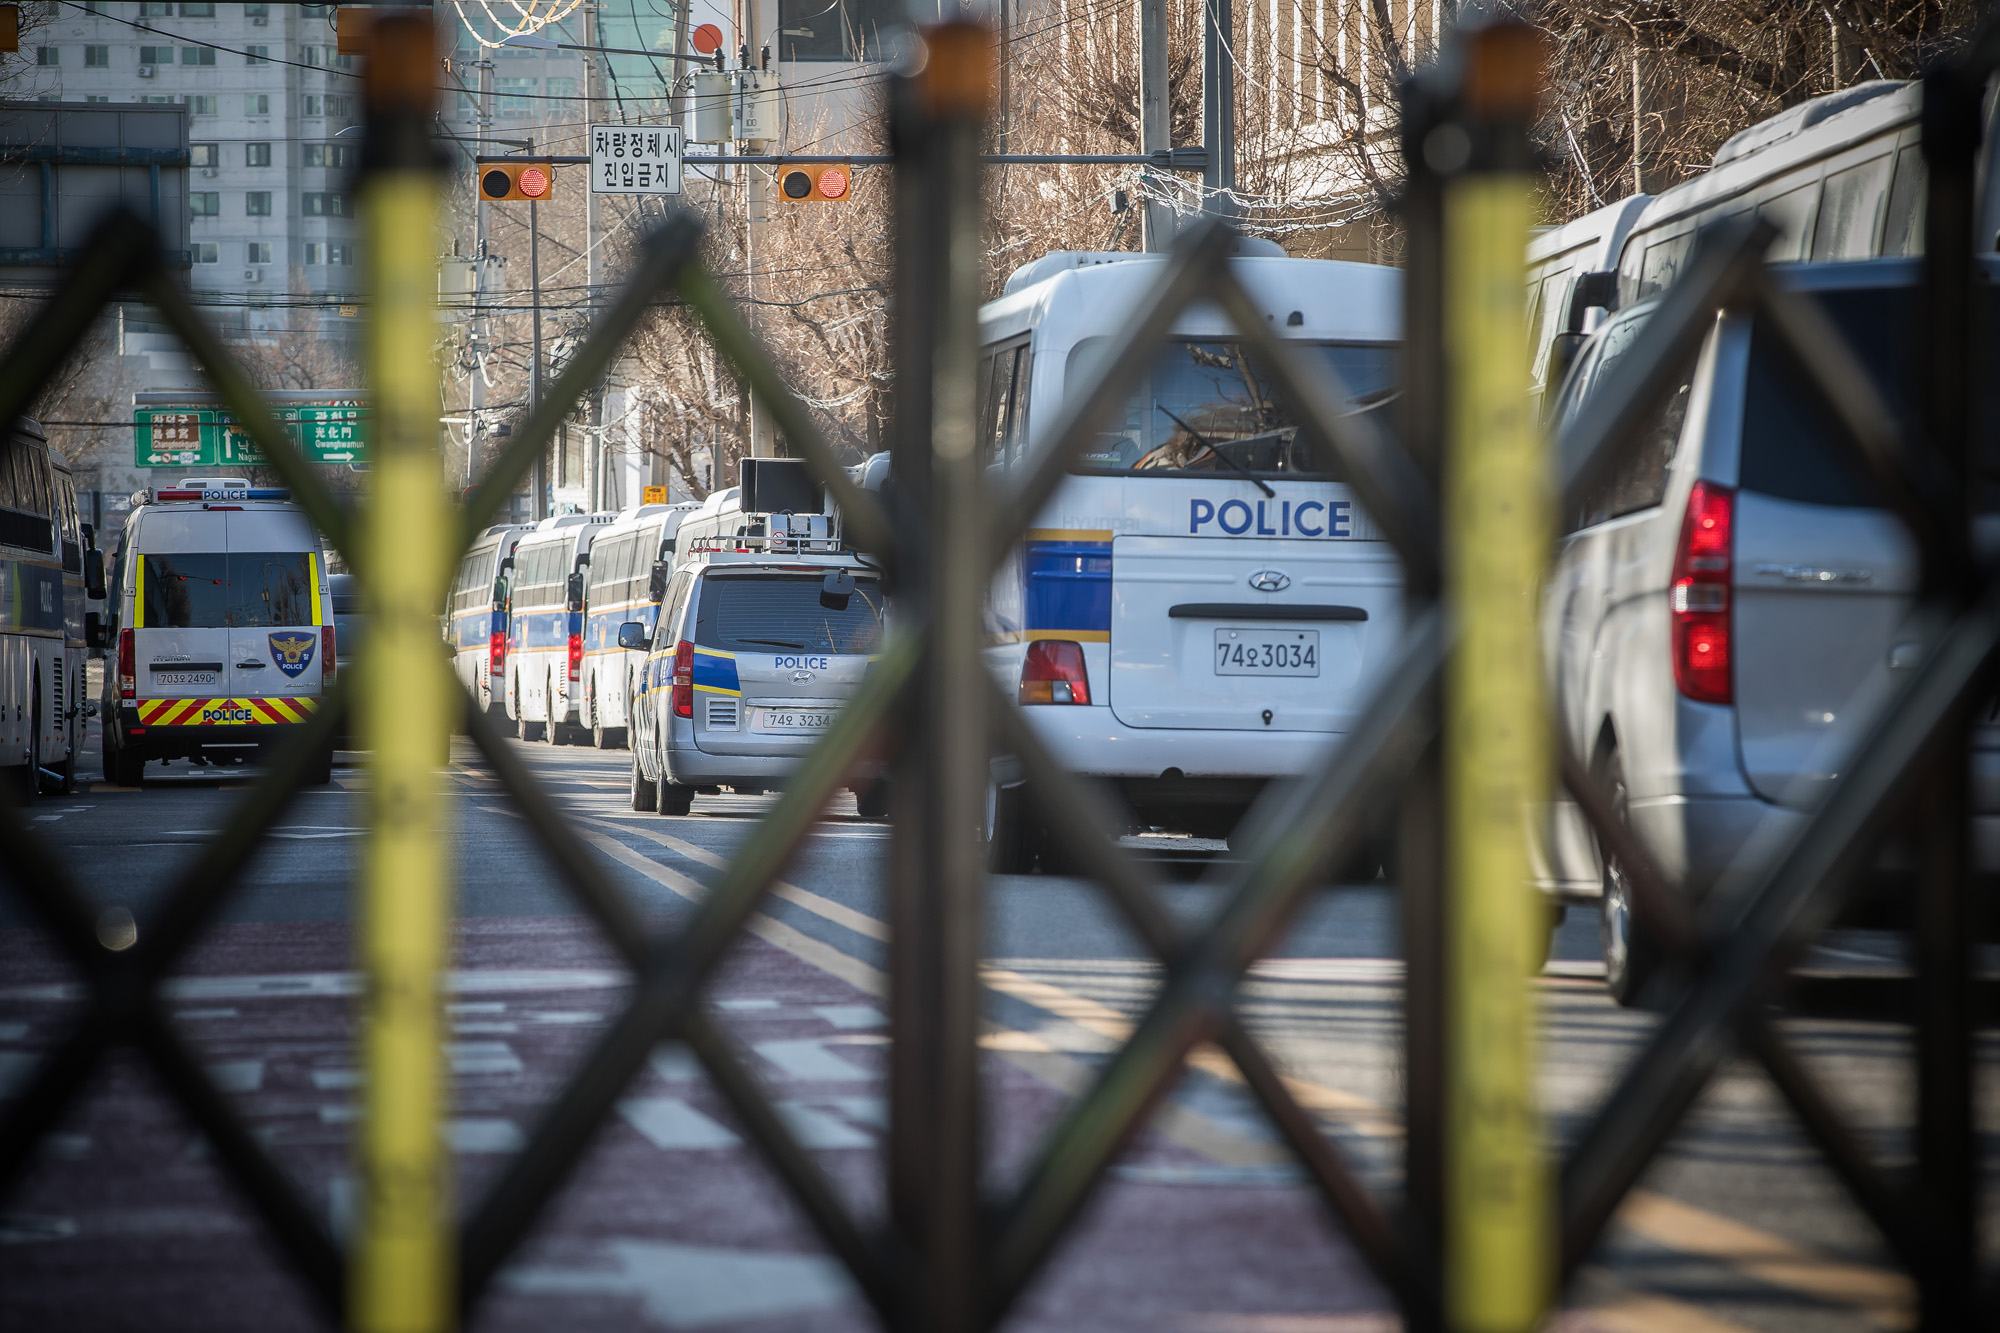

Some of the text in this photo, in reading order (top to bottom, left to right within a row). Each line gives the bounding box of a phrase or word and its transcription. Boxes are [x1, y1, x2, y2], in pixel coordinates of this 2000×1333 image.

[604, 162, 668, 188] 진입금지
[315, 411, 357, 426] 광화문
[315, 426, 352, 439] 光化門
[315, 439, 365, 450] Gwanghwamun
[204, 491, 246, 500] POLICE
[1189, 499, 1351, 537] POLICE
[774, 656, 828, 670] POLICE
[203, 709, 252, 721] POLICE
